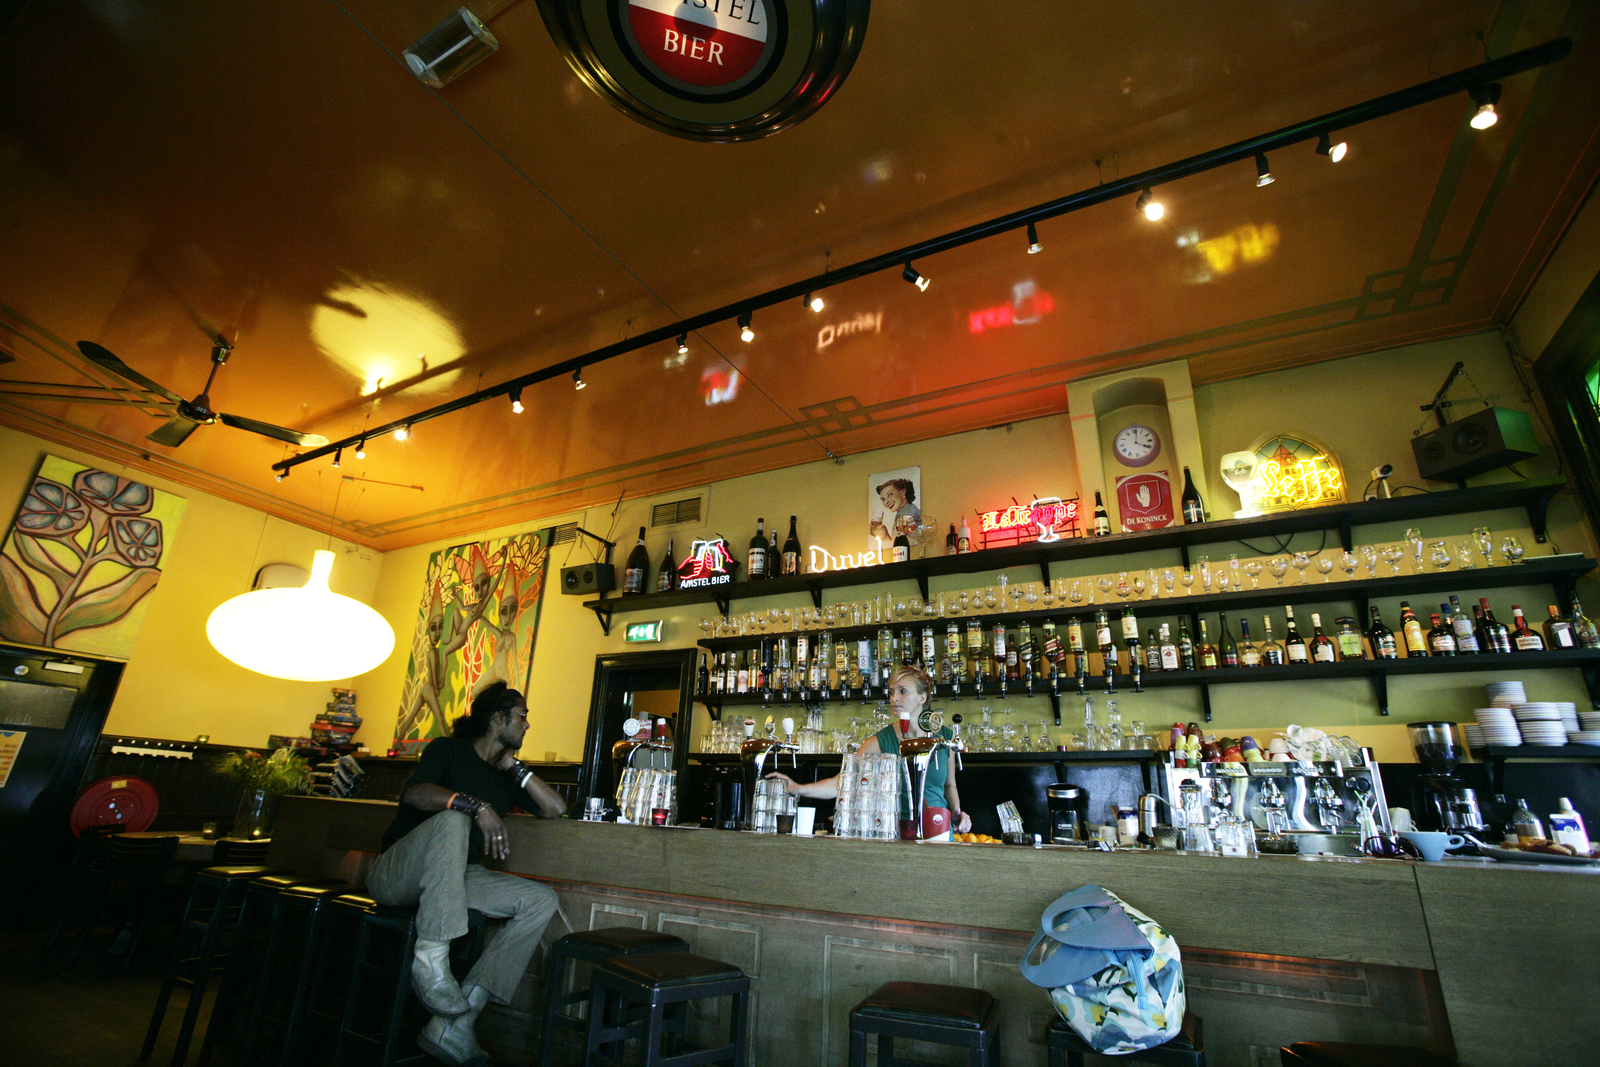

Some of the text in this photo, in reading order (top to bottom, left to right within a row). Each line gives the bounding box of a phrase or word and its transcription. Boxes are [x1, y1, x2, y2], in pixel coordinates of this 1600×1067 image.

[663, 28, 724, 66] BIER
[1136, 514, 1168, 524] KONINCK
[809, 536, 885, 573] Duvel
[680, 574, 730, 589] AMSTEL BIER
